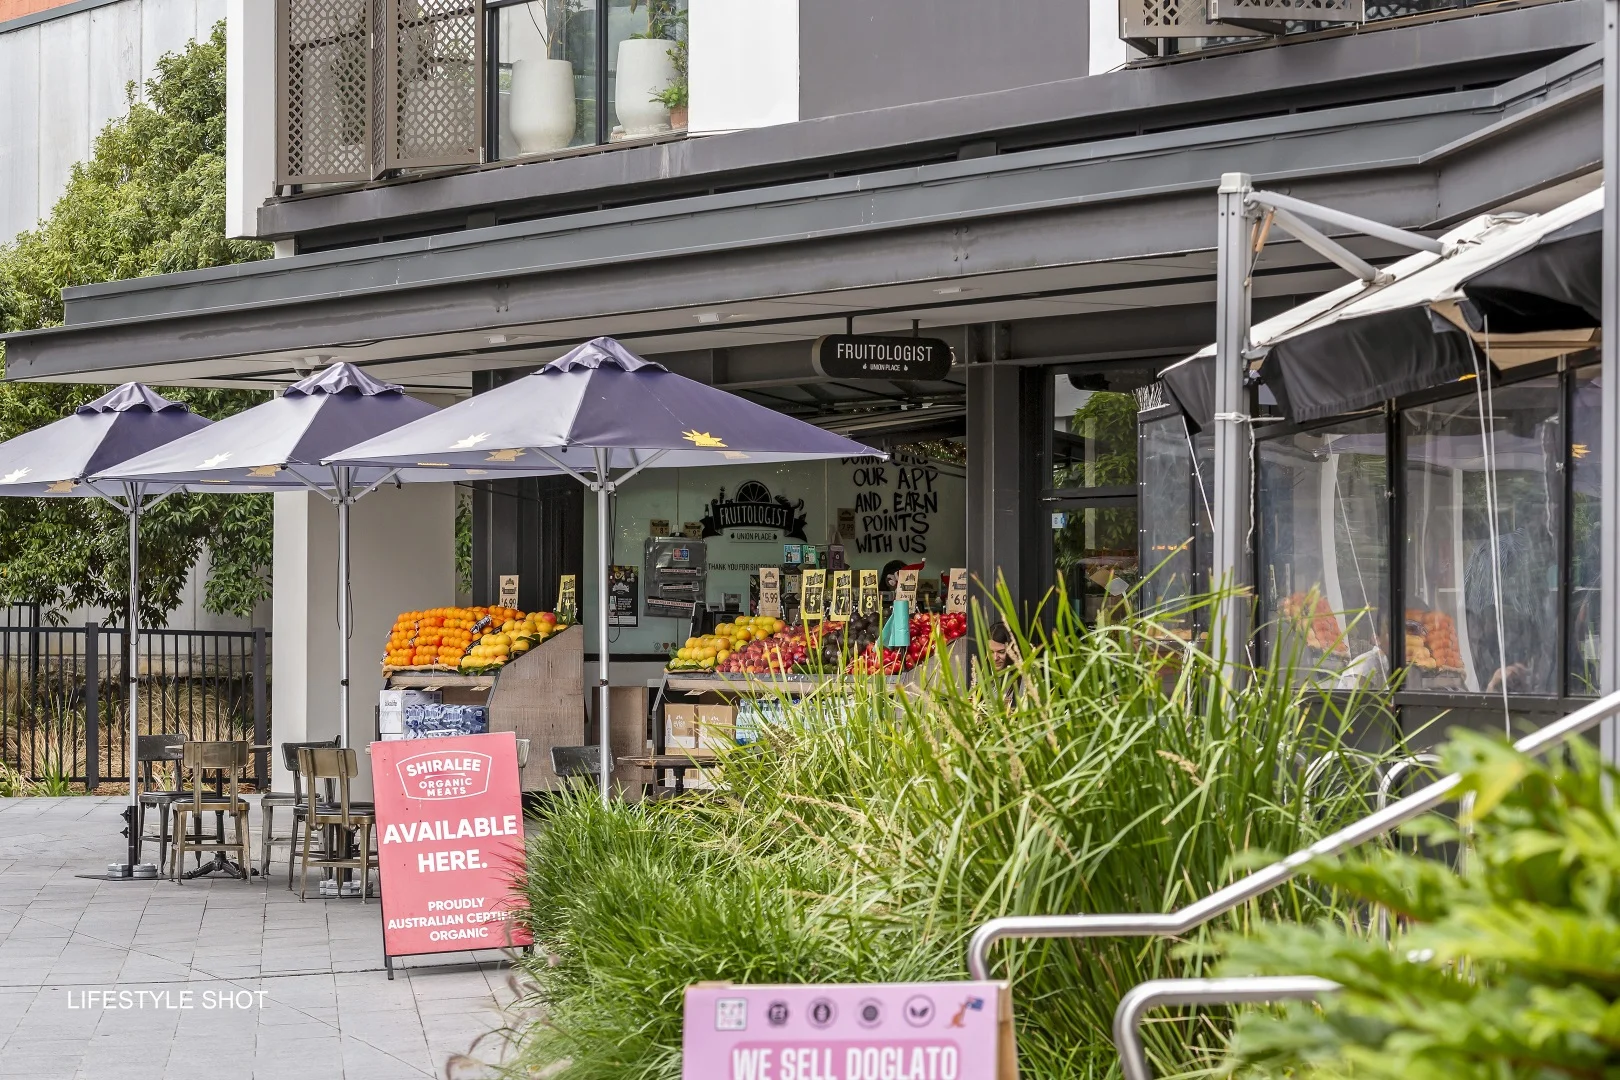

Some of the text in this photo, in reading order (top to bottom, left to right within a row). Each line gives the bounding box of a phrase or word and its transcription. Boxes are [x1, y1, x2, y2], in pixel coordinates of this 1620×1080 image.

[836, 343, 933, 362] FRUITOLOGIST
[869, 363, 901, 372] UNION PLACE
[853, 465, 938, 492] OUR APP
[854, 490, 938, 514] AND EARN
[719, 504, 788, 527] FRUITOLOGIST
[736, 532, 771, 541] UNION PLACE
[855, 533, 927, 554] WITH US
[708, 563, 726, 571] THANK
[727, 563, 739, 571] YOU
[739, 563, 750, 571] FOR
[406, 759, 481, 777] SHIRALEE
[419, 778, 472, 789] ORGANIC
[427, 787, 466, 797] MEATS
[383, 815, 518, 844] AVAILABLE
[418, 849, 488, 873] HERE.
[428, 898, 485, 911] PROUDLY
[388, 914, 464, 930] AUSTRALIAN
[430, 927, 489, 941] ORGANIC
[733, 1046, 958, 1080] WE SELL DOGLATO
